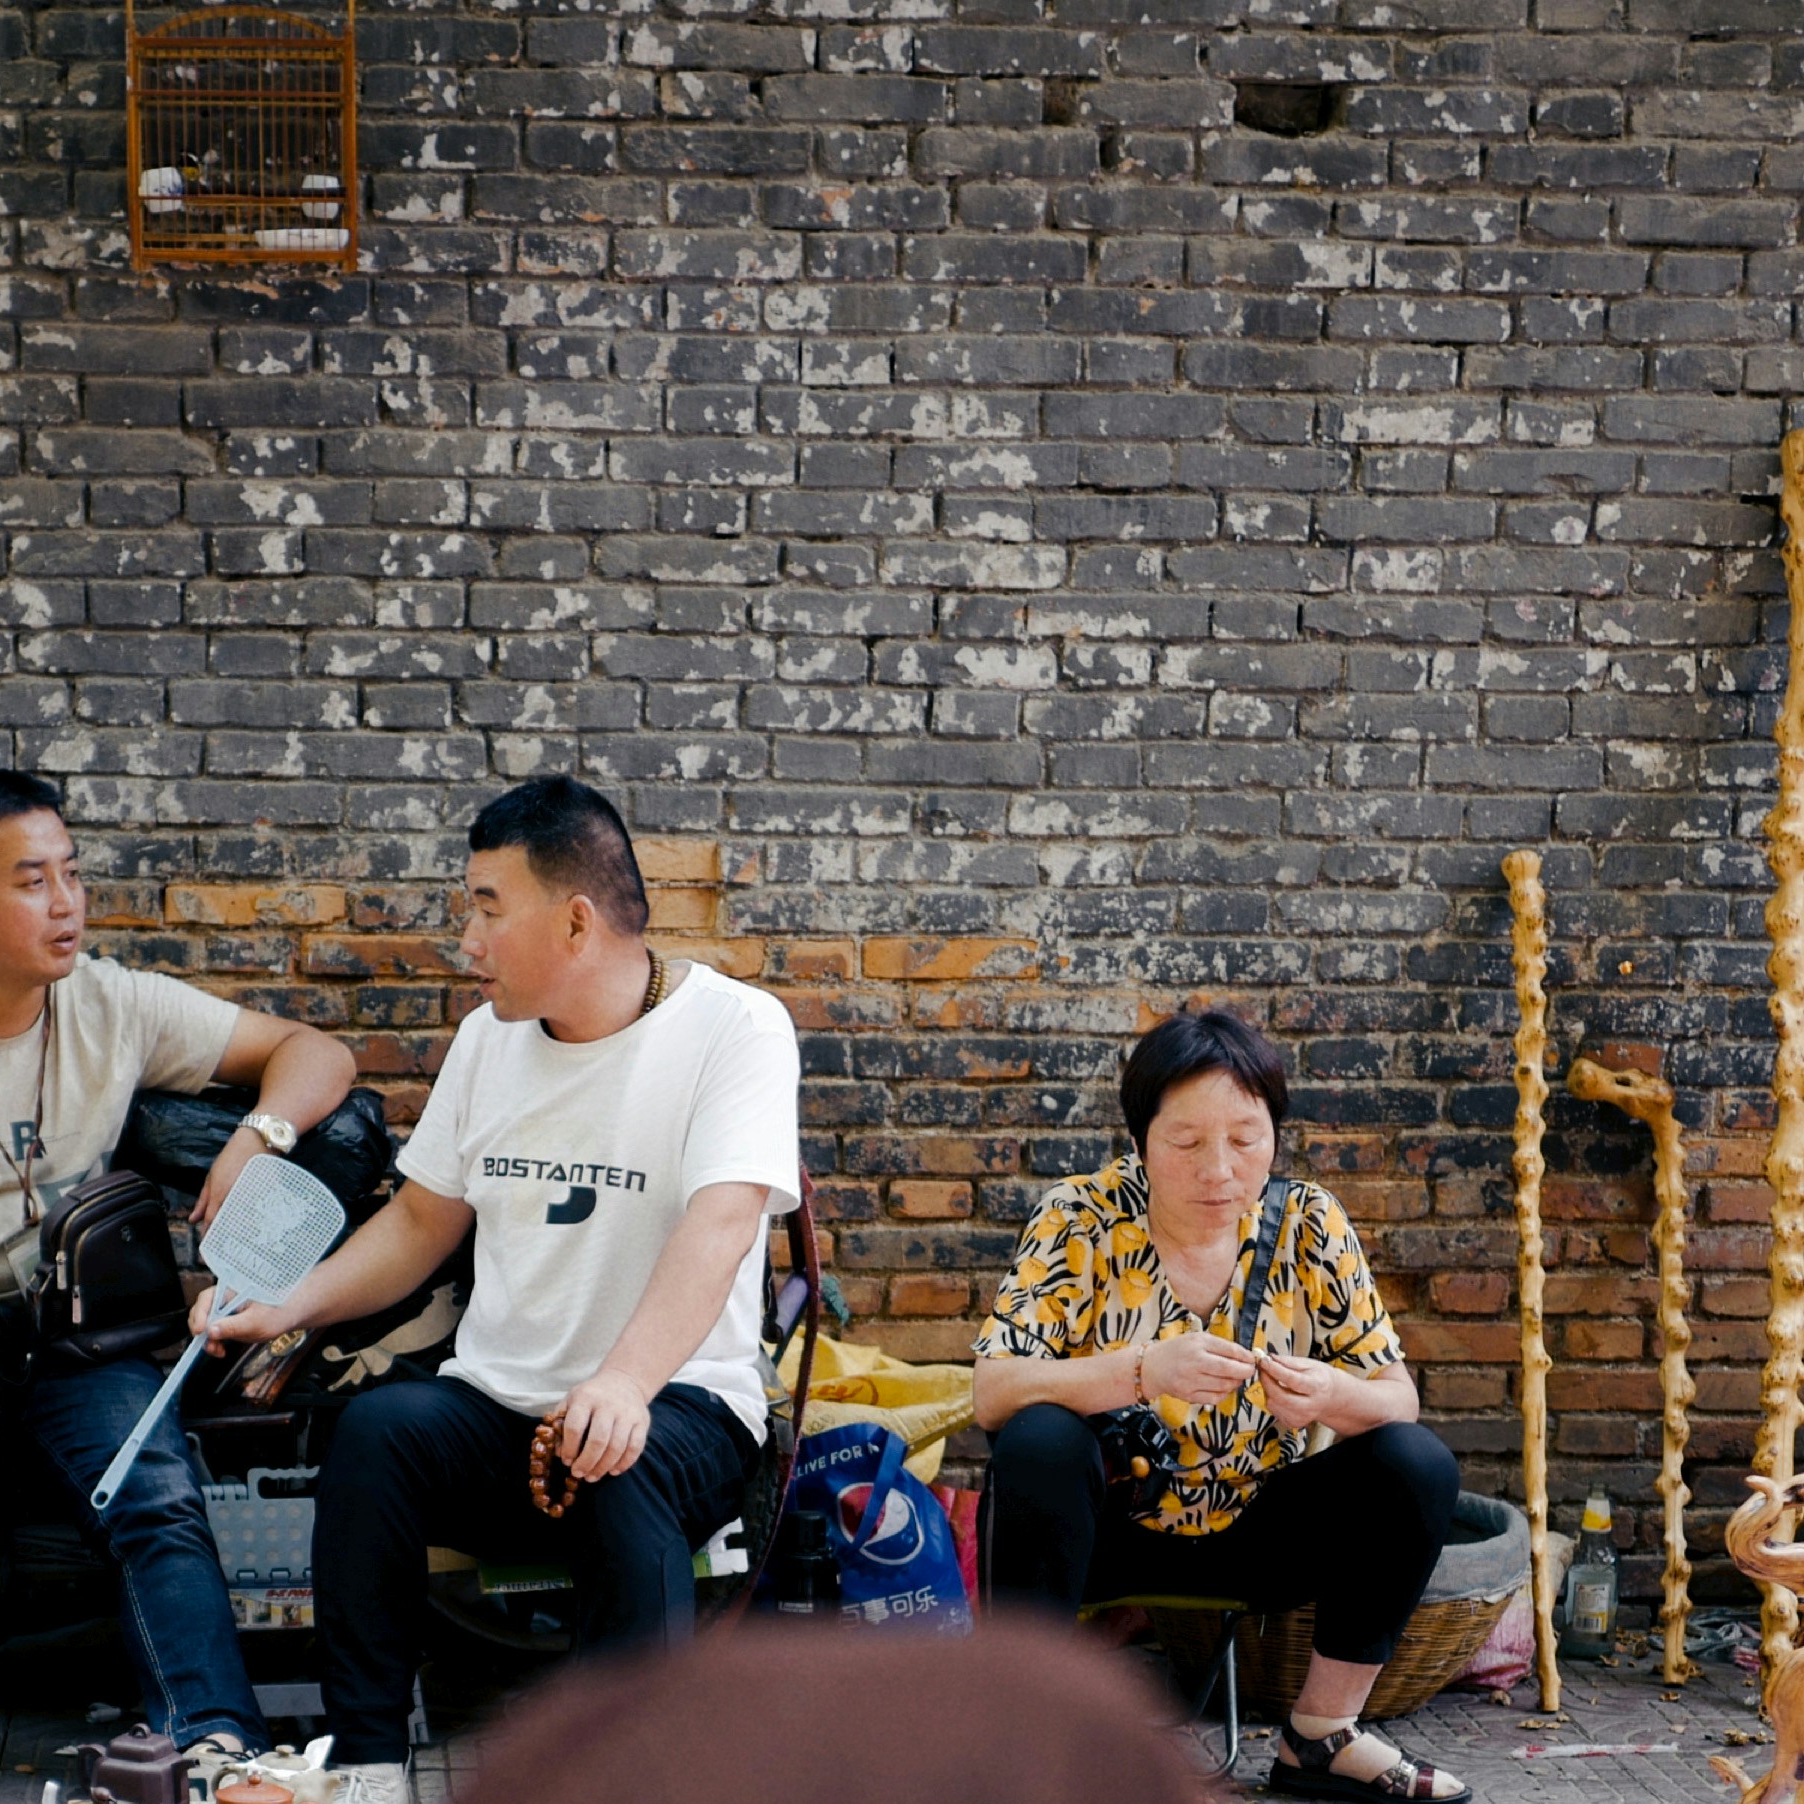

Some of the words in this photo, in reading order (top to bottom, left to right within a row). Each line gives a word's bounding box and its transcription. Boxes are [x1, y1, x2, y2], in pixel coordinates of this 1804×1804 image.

[482, 1157, 647, 1192] BOSTANTEN
[797, 1456, 827, 1477] LIVE
[830, 1445, 863, 1465] FOR
